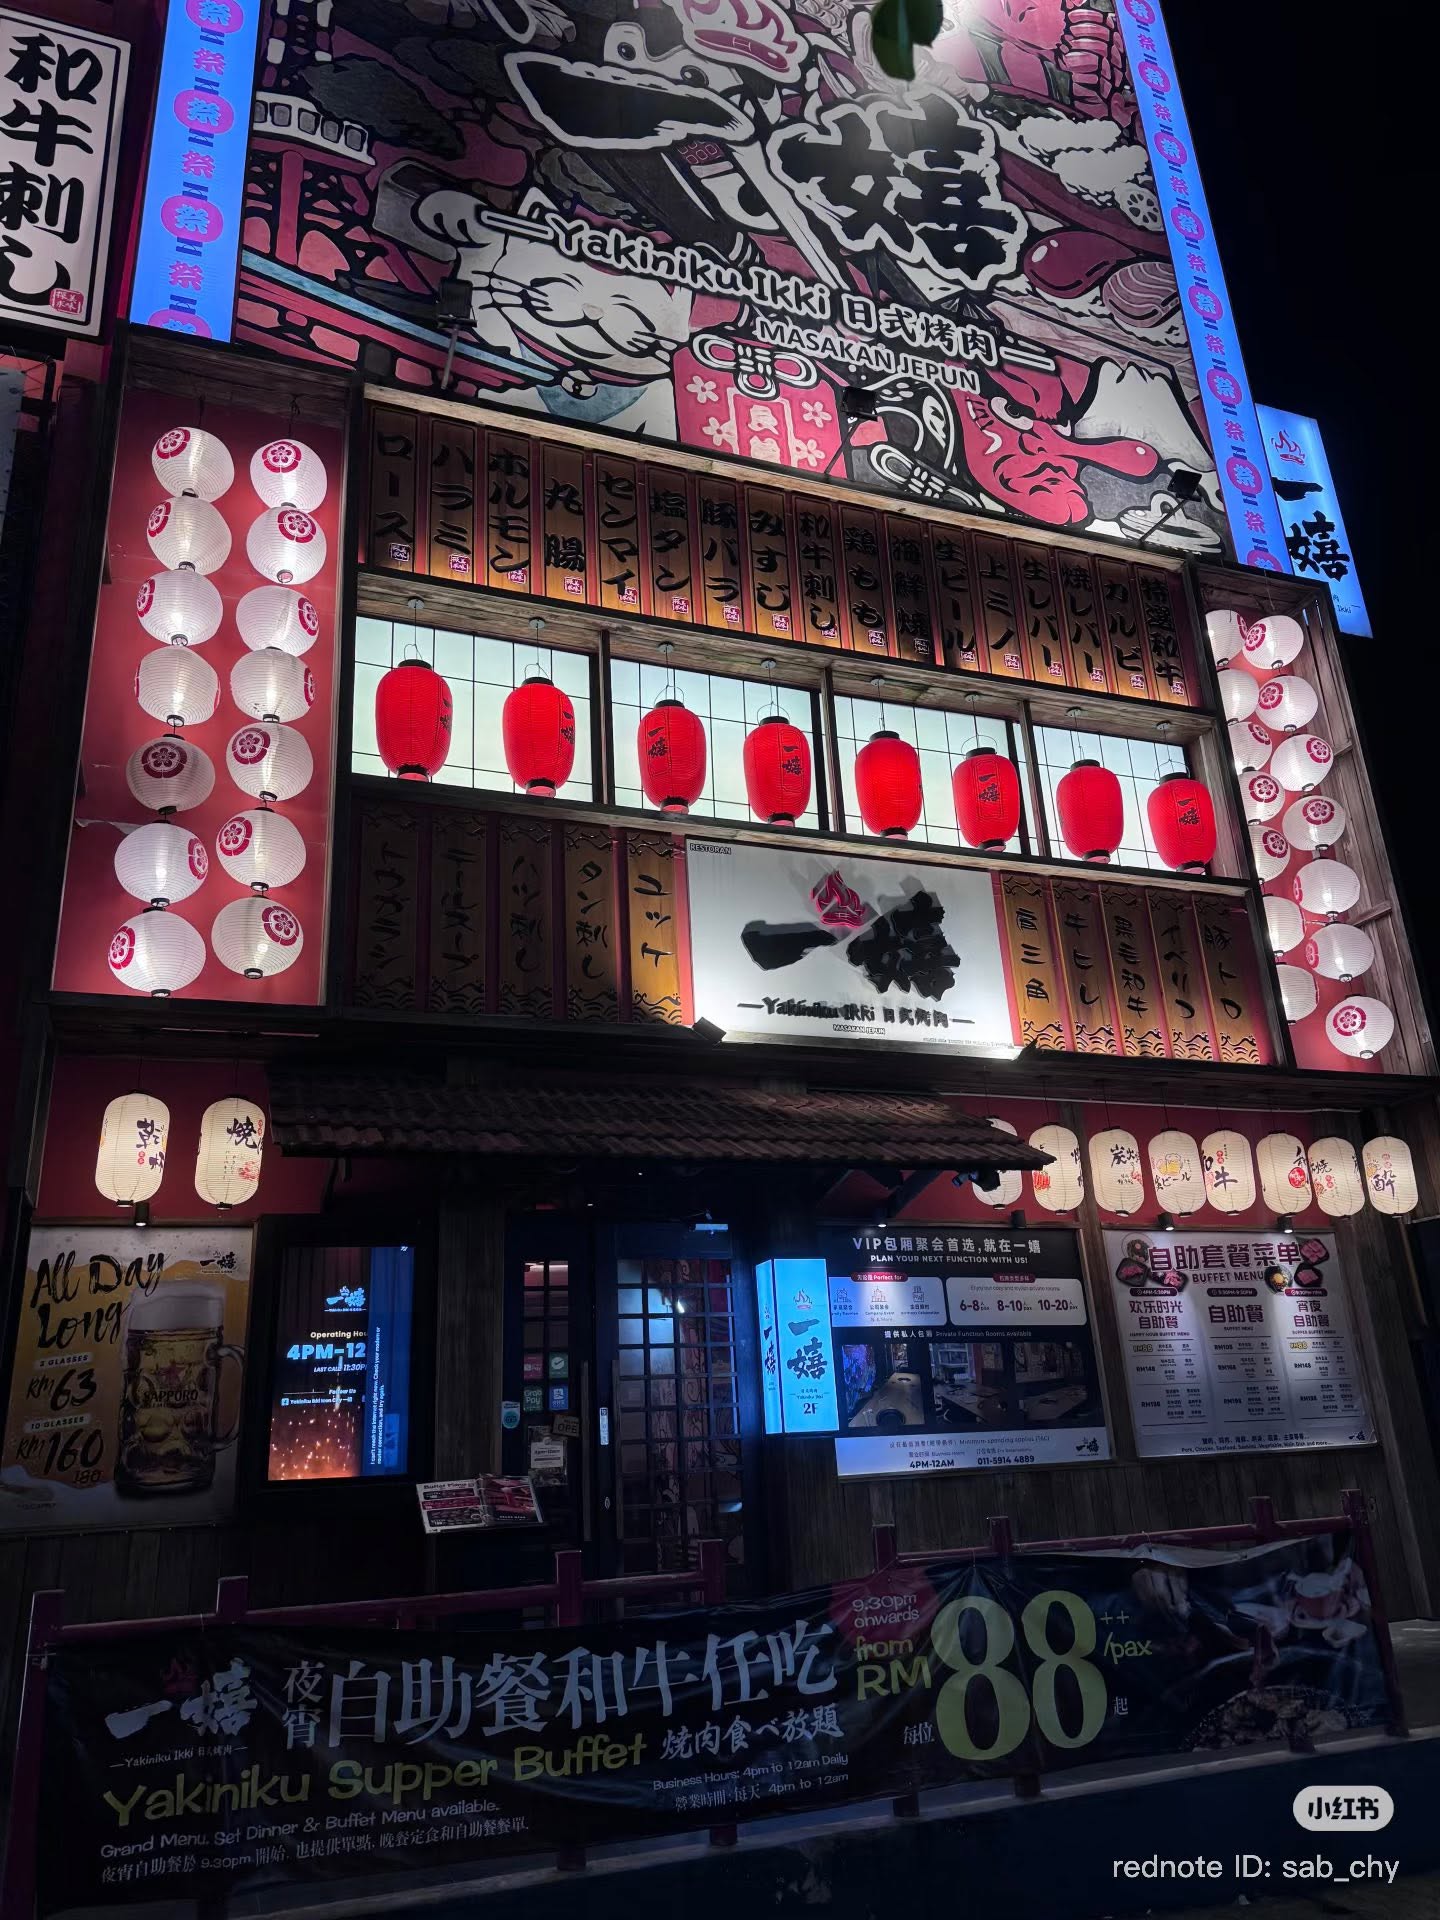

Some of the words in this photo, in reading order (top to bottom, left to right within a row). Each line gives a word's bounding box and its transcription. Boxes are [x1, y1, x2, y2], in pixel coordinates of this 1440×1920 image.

[546, 213, 743, 295] Yakiniku
[751, 270, 830, 317] Ikki
[842, 293, 998, 367] 日式烤肉
[757, 316, 897, 373] MASAKAN
[898, 352, 981, 396] JEPUN
[690, 843, 732, 855] RESTORAN
[871, 1255, 894, 1263] PLAN
[896, 1255, 920, 1263] YOUR
[923, 1256, 943, 1264] NEXT
[946, 1256, 988, 1264] FUNCTION
[990, 1256, 1013, 1264] WITH
[1149, 1242, 1302, 1271] 自助套餐菜单
[30, 1250, 80, 1308] All
[89, 1252, 170, 1297] Day
[1192, 1271, 1231, 1283] BUFFET
[1234, 1271, 1265, 1281] MENU
[959, 1299, 980, 1312] 6-8
[997, 1299, 1023, 1312] 8-10
[1038, 1299, 1068, 1312] 10-20
[1130, 1300, 1184, 1314] 欢乐时光
[1208, 1304, 1265, 1324] 自助餐
[37, 1301, 131, 1349] Long
[1138, 1315, 1179, 1329] 自助餐
[1293, 1314, 1330, 1328] 自助餐
[310, 1330, 351, 1341] Operating
[287, 1342, 366, 1360] 4PM-12
[787, 1318, 828, 1380] 一嬉
[48, 1354, 89, 1366] GLASSES
[26, 1368, 97, 1412] RM63
[143, 1388, 199, 1403] SAPPORO
[803, 1402, 818, 1415] 2F
[44, 1416, 84, 1429] GLASSES
[16, 1428, 104, 1475] RM160
[909, 1459, 955, 1468] 4PM-12AM
[854, 1608, 920, 1630] onwards
[854, 1635, 914, 1662] from
[329, 1620, 838, 1748] 自助餐和牛任吃
[282, 1660, 324, 1749] 夜宵
[125, 1753, 171, 1768] Yakiniku
[104, 1764, 312, 1828] Yakiniku
[328, 1758, 498, 1806] Supper
[513, 1732, 648, 1782] Buffet
[653, 1775, 702, 1791] Business
[704, 1770, 740, 1784] Hours:
[743, 1766, 770, 1780] 4pm
[771, 1763, 784, 1774] to
[788, 1757, 820, 1771] 12am
[822, 1753, 849, 1768] Daily
[768, 1780, 796, 1794] 4pm
[799, 1777, 812, 1789] to
[816, 1771, 849, 1786] 12am
[101, 1836, 154, 1859] Grand
[214, 1830, 242, 1847] Set
[245, 1823, 299, 1841] Dinner
[303, 1818, 322, 1833] &
[326, 1815, 377, 1830] Buffet
[381, 1810, 426, 1825] Menu
[431, 1800, 499, 1818] available.
